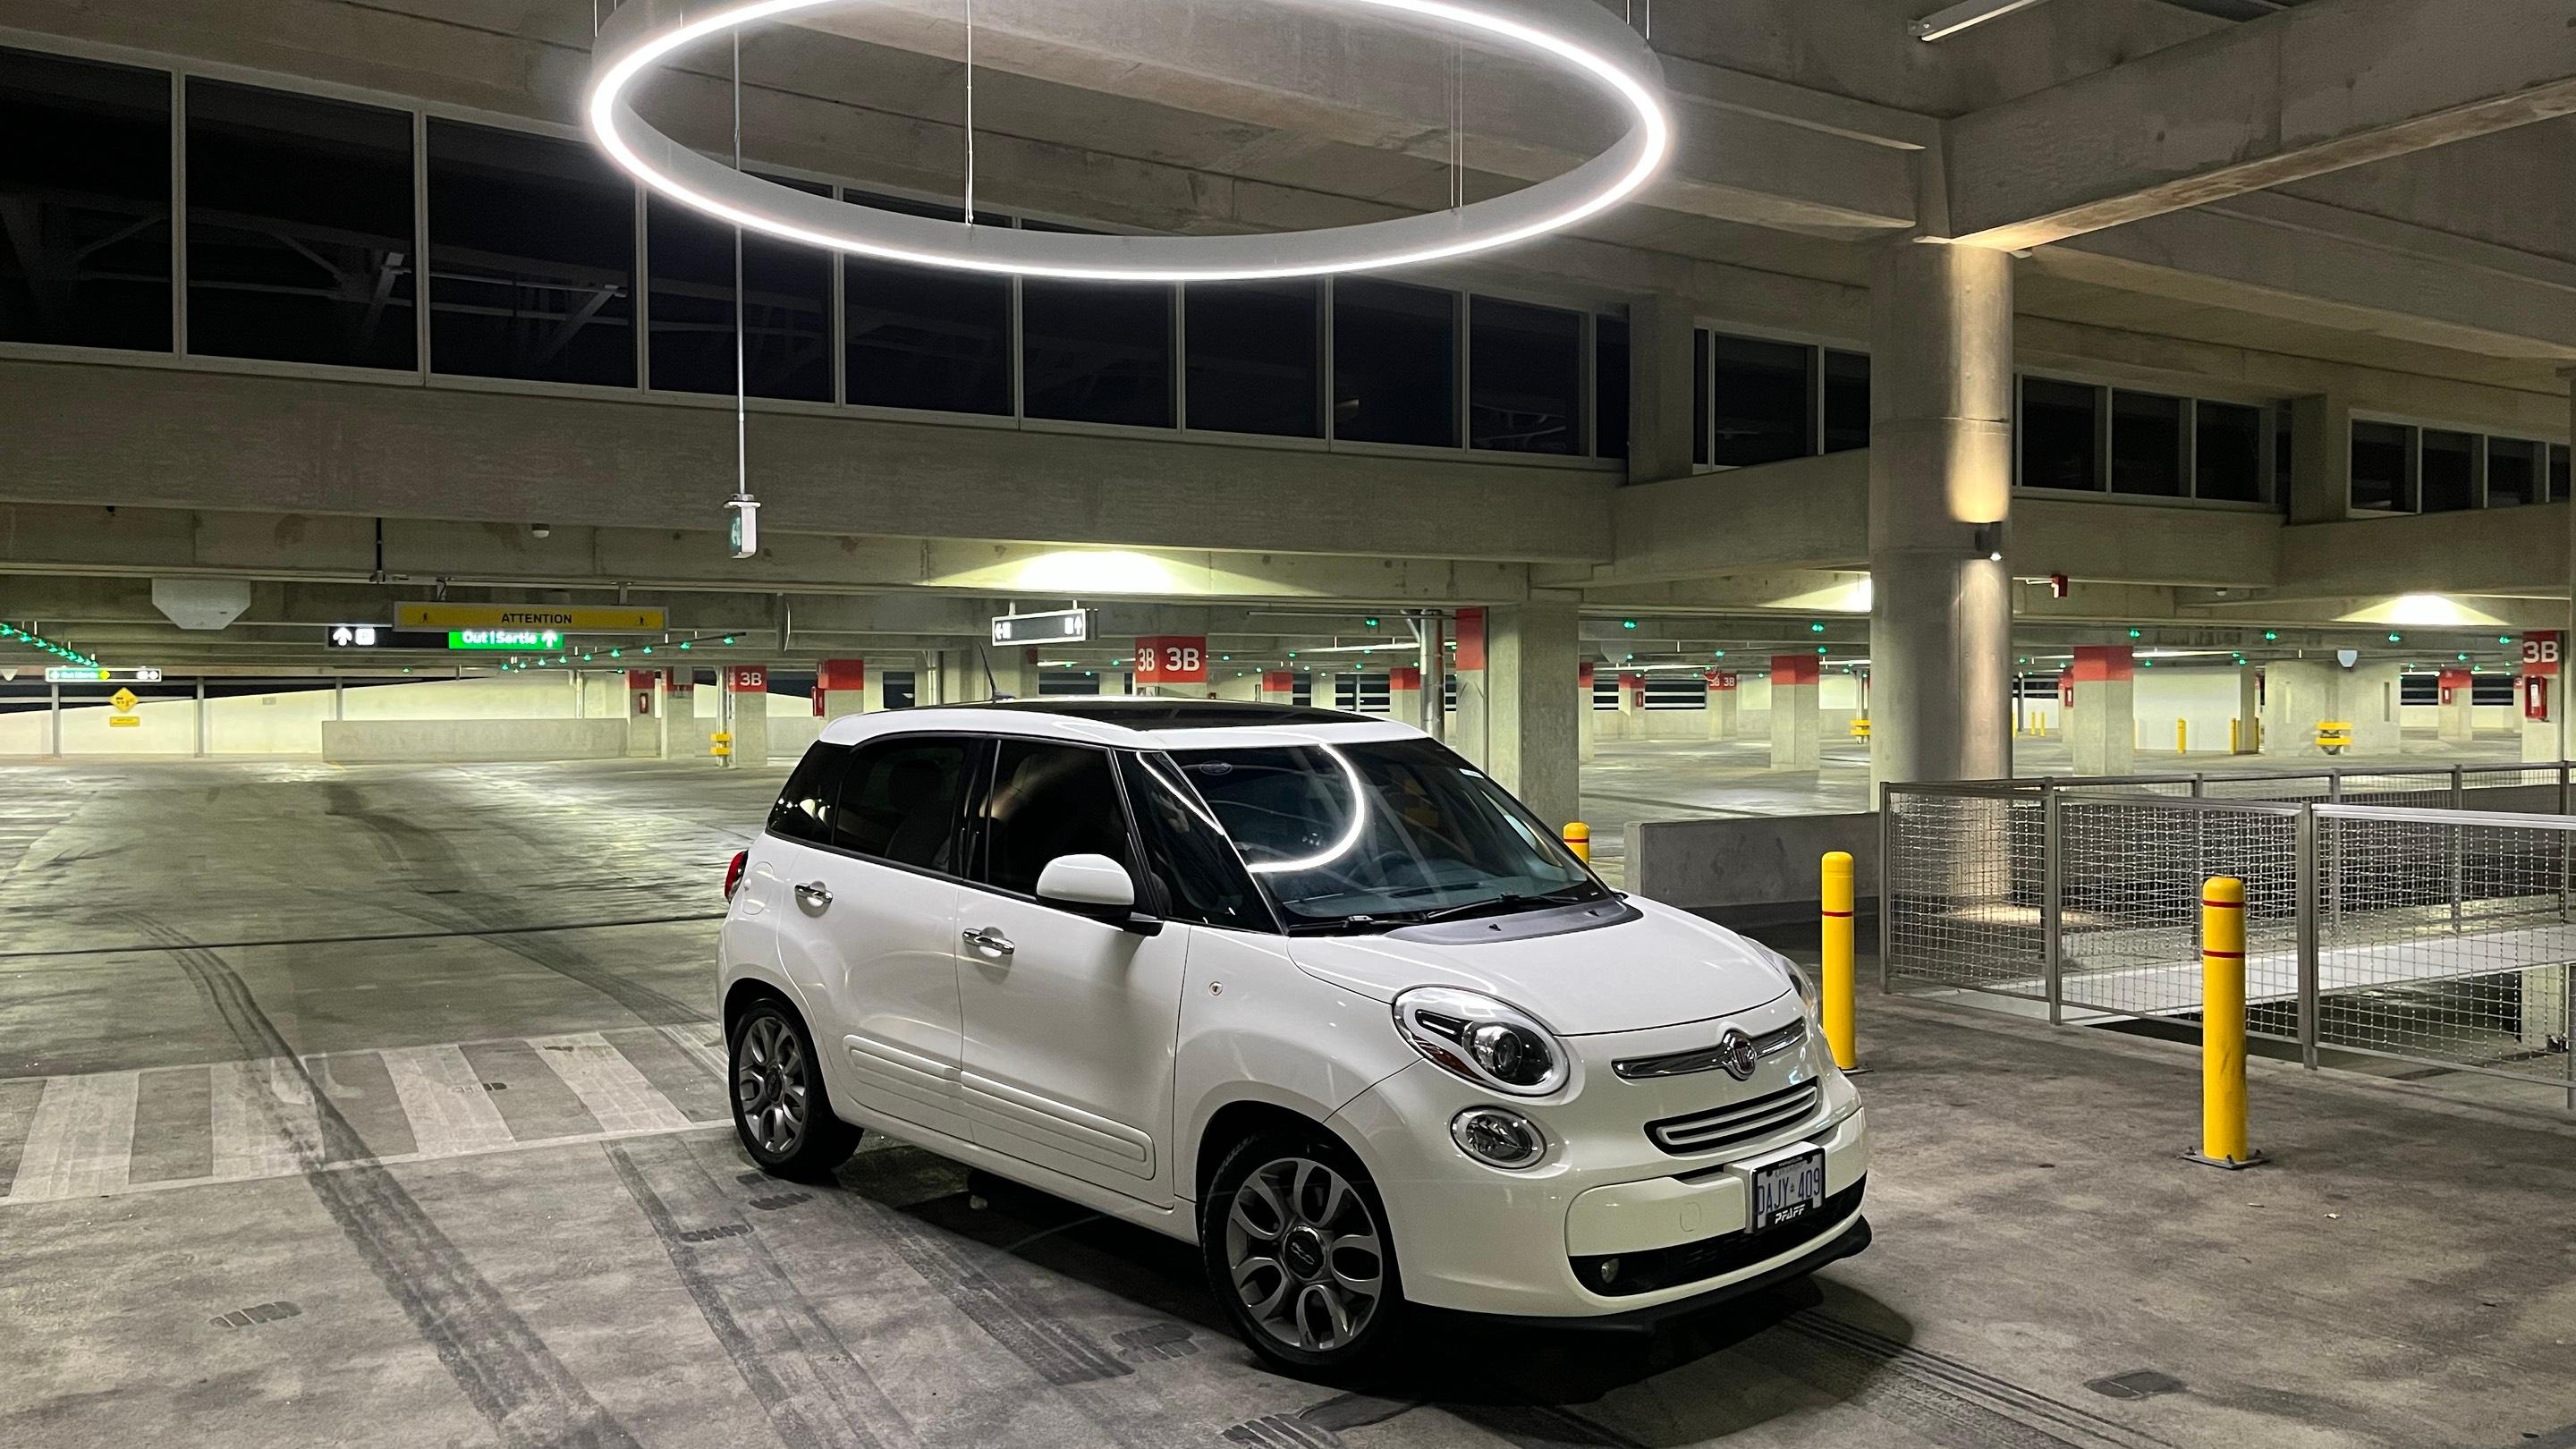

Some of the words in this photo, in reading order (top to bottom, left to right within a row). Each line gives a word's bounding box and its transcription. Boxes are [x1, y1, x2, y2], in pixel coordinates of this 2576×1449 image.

[501, 613, 572, 624] ATTENTION
[462, 630, 488, 644] Out
[496, 631, 538, 645] Sortie
[1137, 648, 1156, 672] 3B
[1165, 647, 1200, 672] 3B
[2522, 640, 2558, 664] 3B
[740, 672, 762, 686] 3B
[1724, 677, 1735, 687] 3B
[1758, 1176, 1790, 1216] DAJY
[1798, 1166, 1821, 1200] 409
[1775, 1203, 1807, 1224] PFAFF
